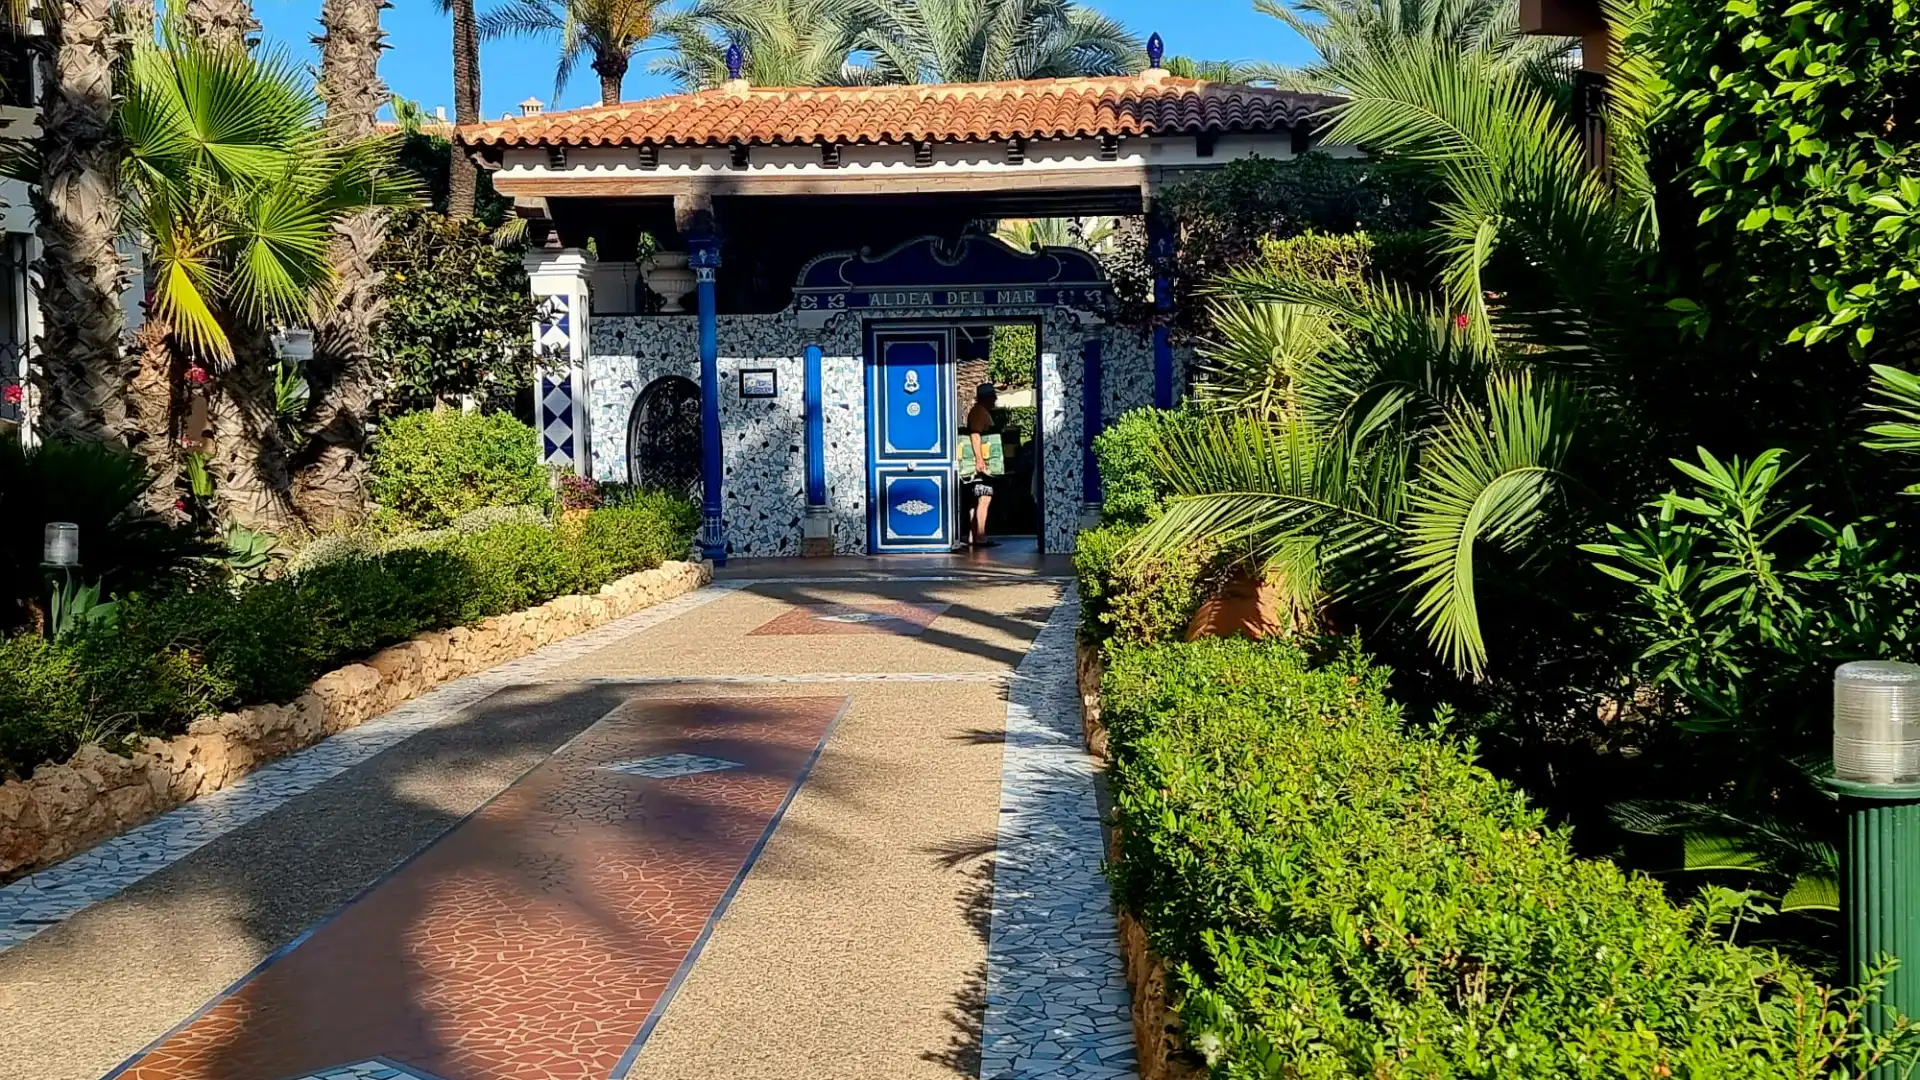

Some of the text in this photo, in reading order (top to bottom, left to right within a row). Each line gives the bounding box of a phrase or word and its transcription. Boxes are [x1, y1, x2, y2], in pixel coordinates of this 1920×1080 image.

[870, 290, 1036, 306] ALDEA DEL MAR
